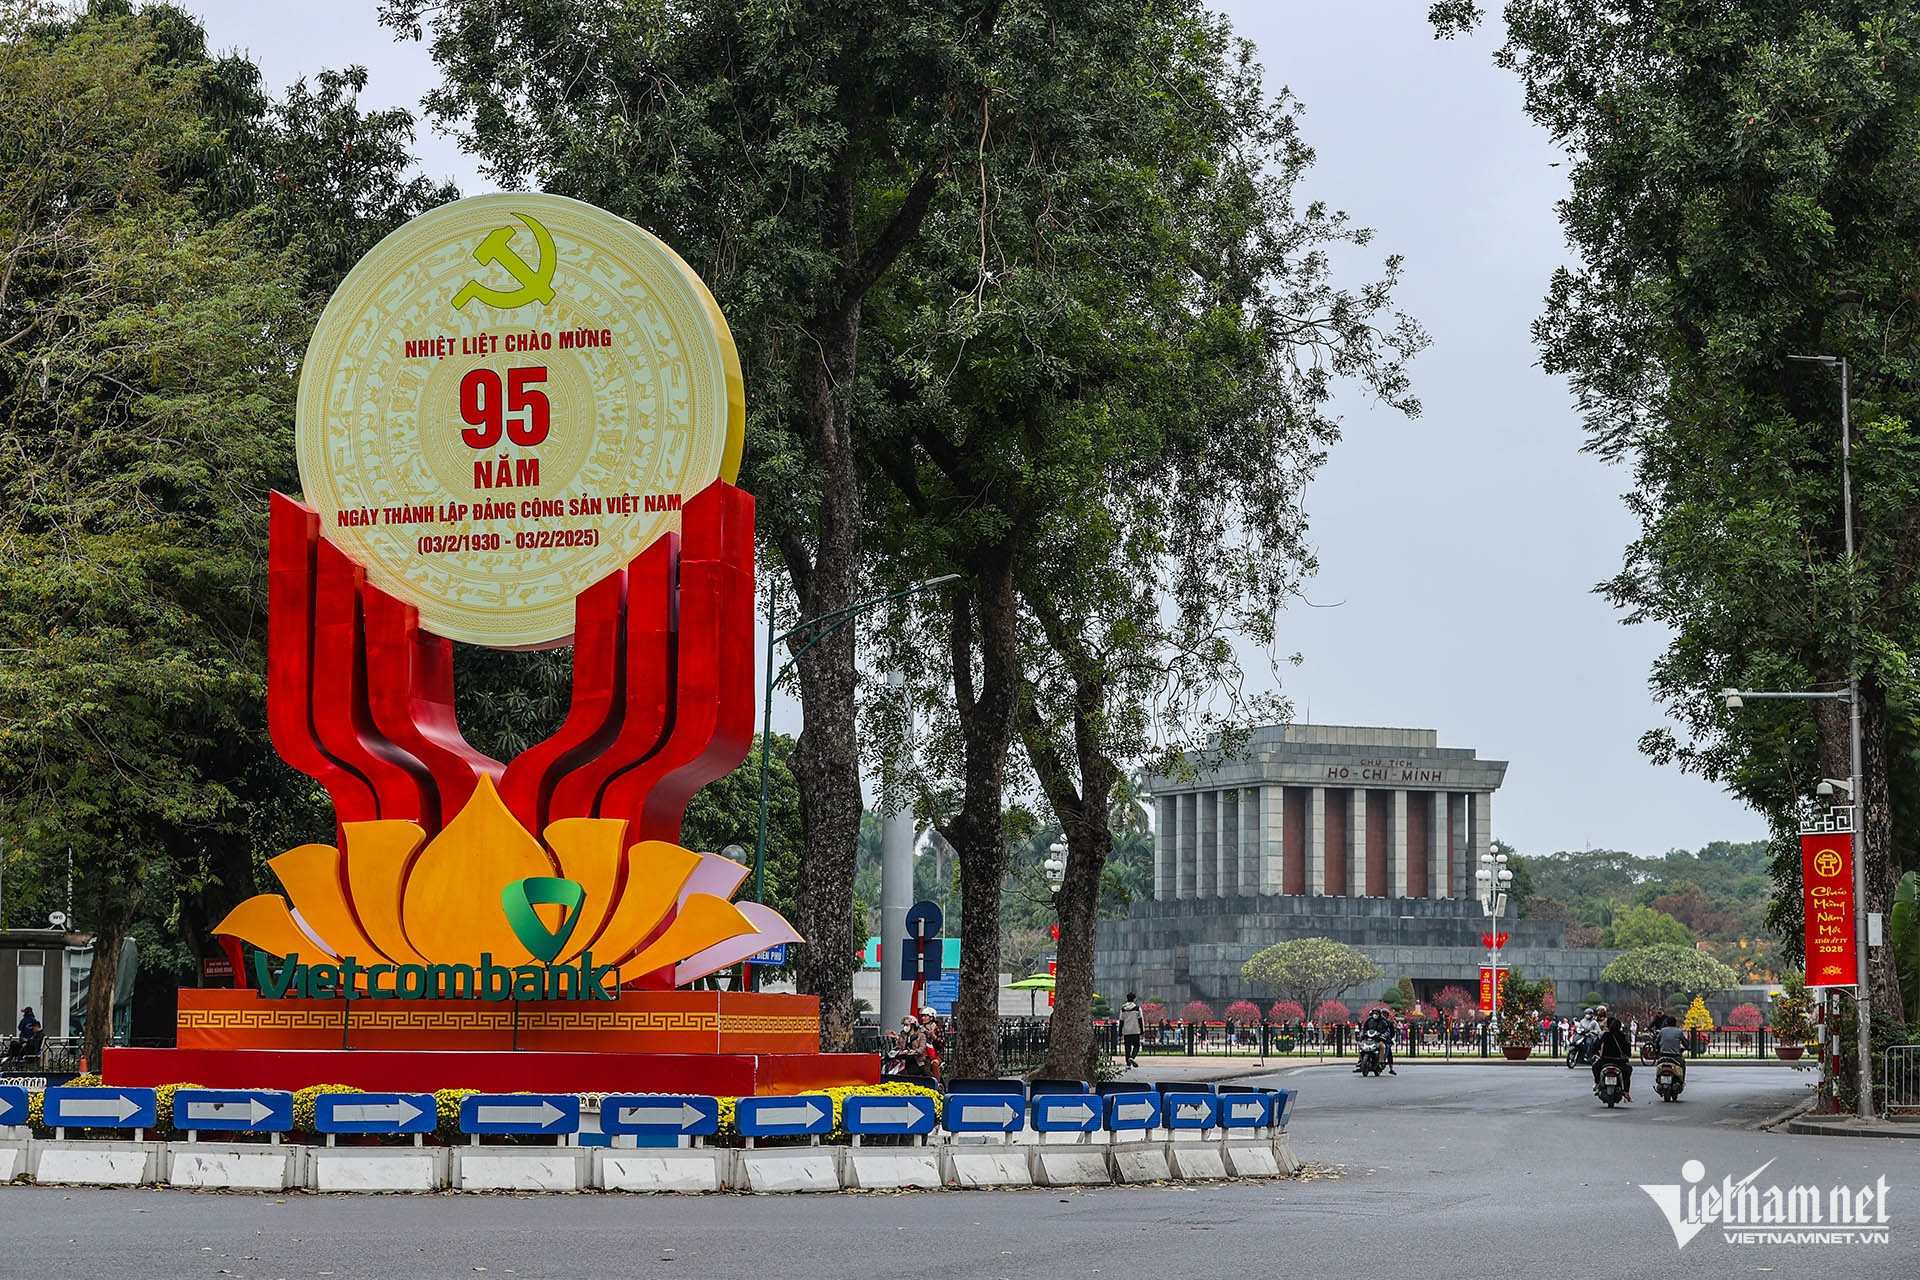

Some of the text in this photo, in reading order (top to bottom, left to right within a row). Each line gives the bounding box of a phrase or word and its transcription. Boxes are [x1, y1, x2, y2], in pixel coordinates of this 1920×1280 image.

[405, 327, 612, 360] NHIỆT LIỆT CHÀO MỪNG
[459, 366, 550, 449] 95
[474, 453, 540, 489] NĂM
[337, 493, 682, 527] NGÀY THÀNH LẬP ĐẢNG CỘNG SẢN VIỆT NAM
[417, 533, 500, 555] (03/2/1930
[515, 528, 599, 550] 03/2/2025)
[1819, 945, 1843, 953] 2025
[254, 950, 618, 1001] Vietcombank
